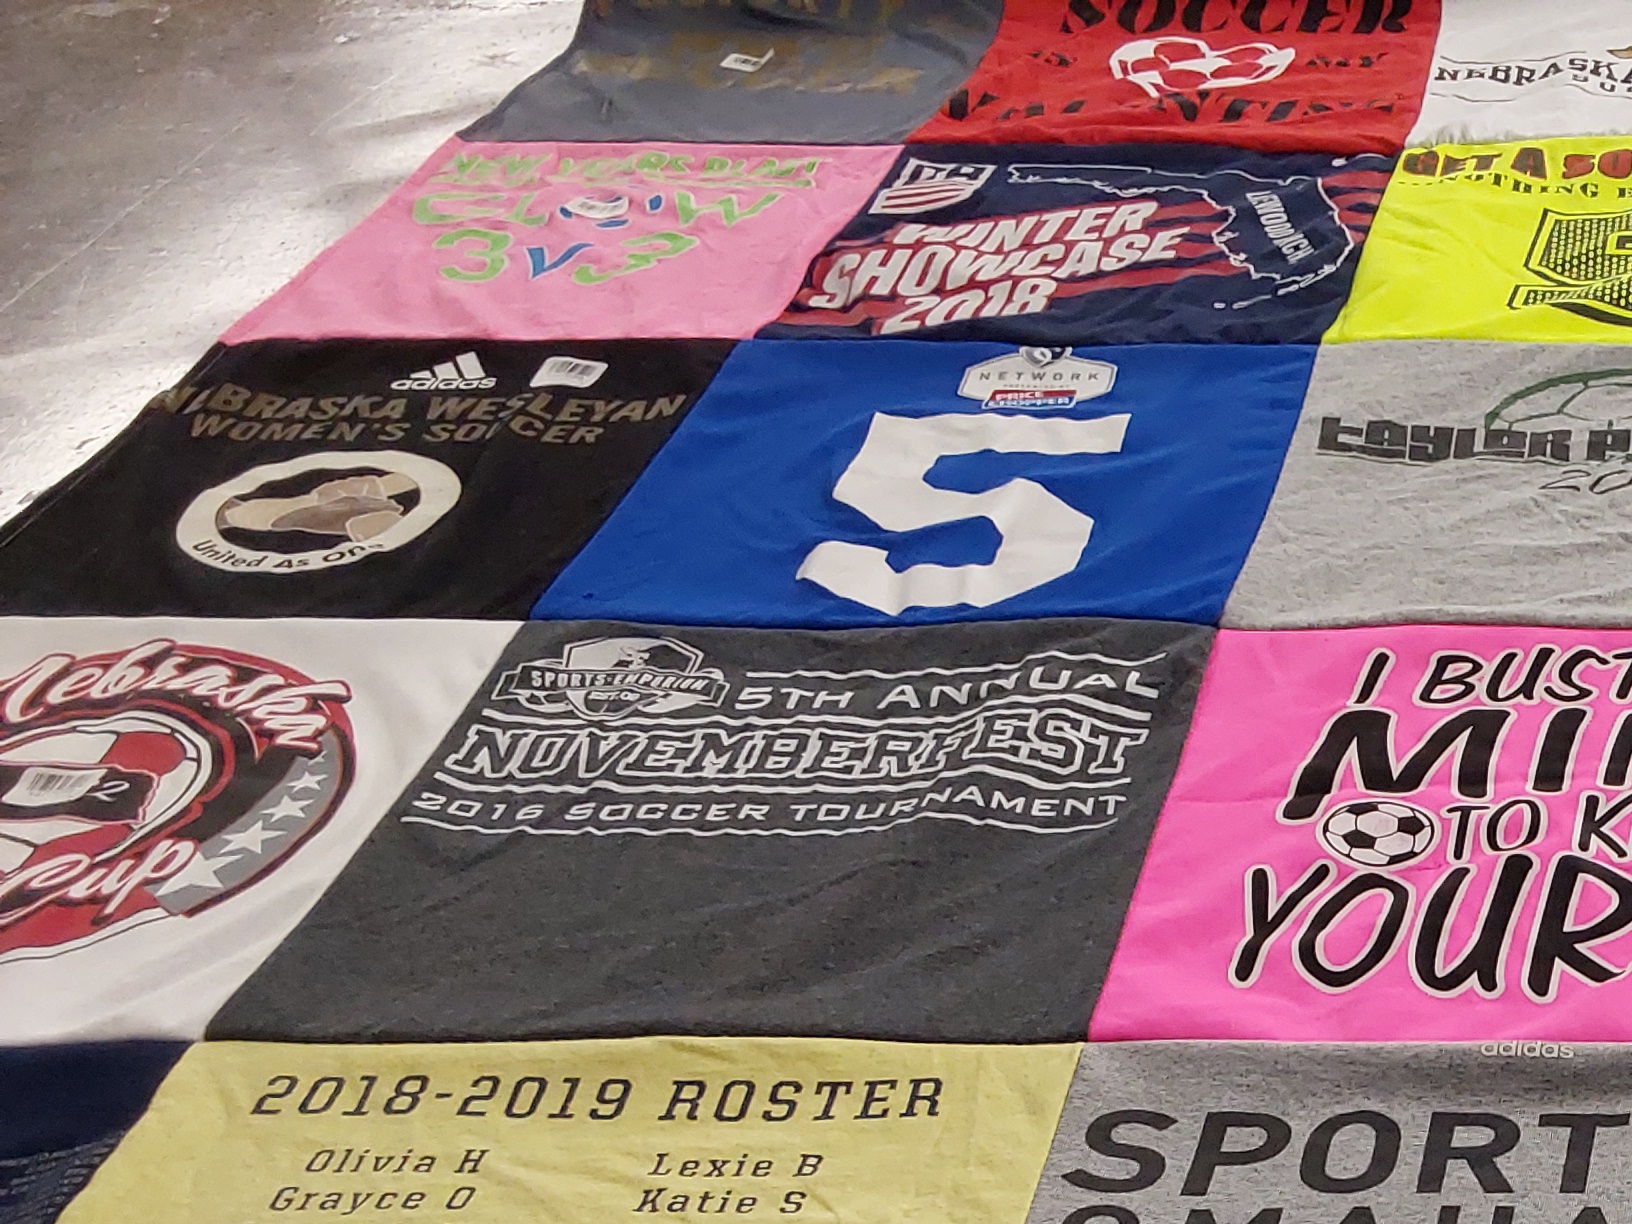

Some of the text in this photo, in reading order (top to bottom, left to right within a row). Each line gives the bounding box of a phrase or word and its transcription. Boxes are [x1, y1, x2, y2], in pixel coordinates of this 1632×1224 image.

[1510, 146, 1547, 180] A
[893, 202, 1158, 252] WINTER
[809, 227, 1190, 309] SHOWCASE
[878, 277, 1057, 335] 2018
[391, 378, 497, 390] adidas
[978, 371, 1101, 382] NETWORK
[190, 413, 411, 442] WOMEN'S
[795, 410, 1133, 617] 5
[192, 539, 268, 568] United
[273, 558, 310, 570] As
[734, 664, 1162, 710] 5TH ANNUAL
[1353, 652, 1390, 705] I
[443, 708, 1150, 780] NOVEMBERFEST
[410, 785, 1128, 823] 2016 SOCCER TOURNAMENT
[1445, 799, 1540, 860] TO
[1480, 1040, 1575, 1059] adidas
[251, 1075, 942, 1122] 2018-2019 ROSTER
[305, 1149, 489, 1173] Olivia H
[648, 1153, 823, 1177] Lexie B
[269, 1187, 426, 1215] Grayce
[633, 1188, 807, 1213] Katie S
